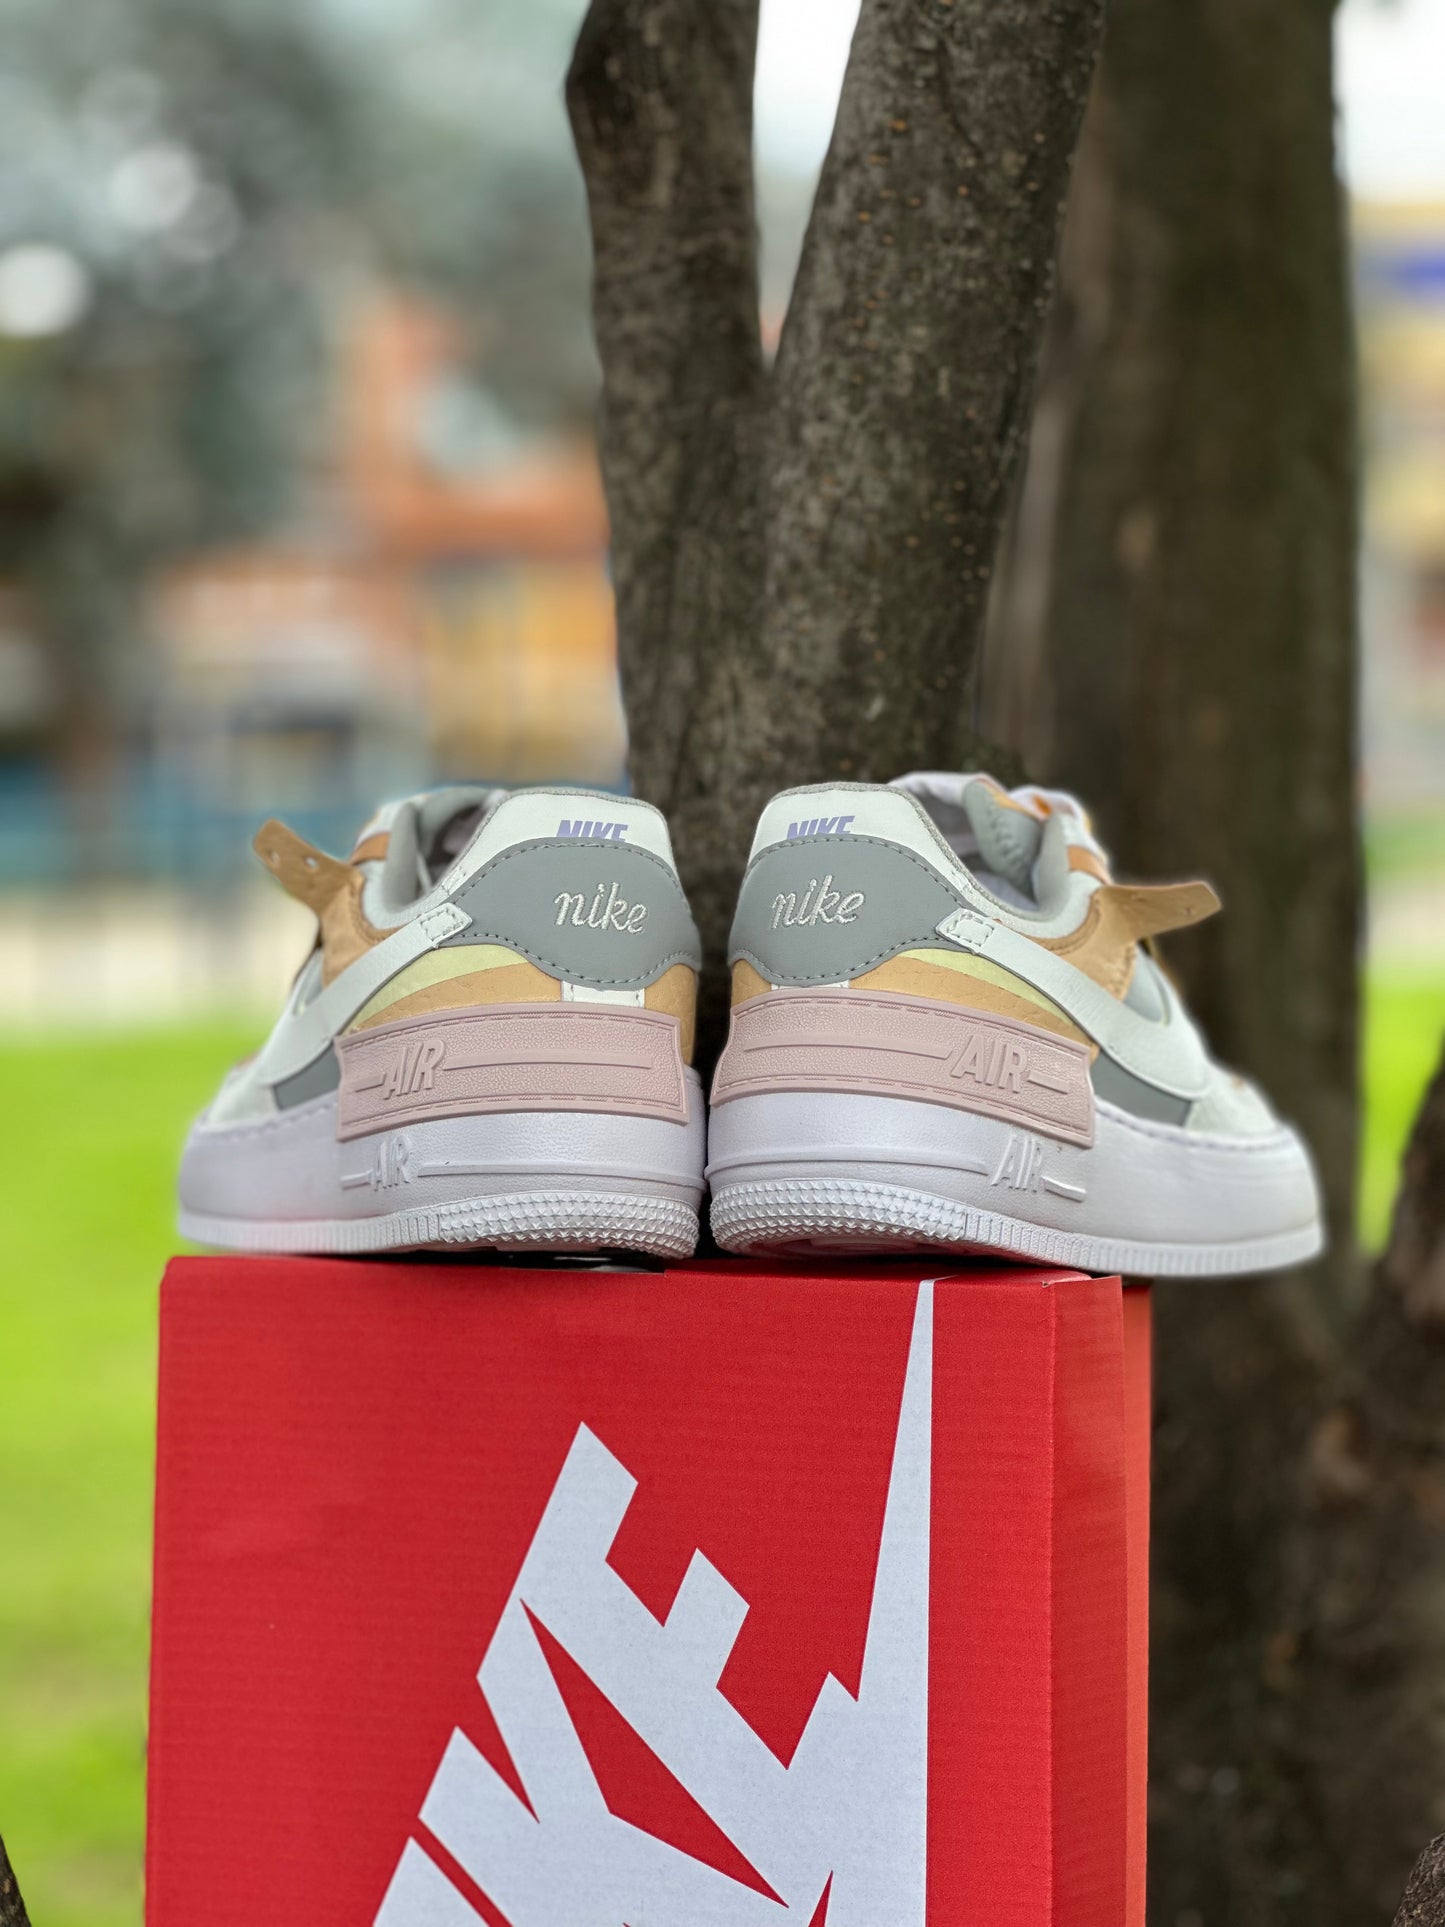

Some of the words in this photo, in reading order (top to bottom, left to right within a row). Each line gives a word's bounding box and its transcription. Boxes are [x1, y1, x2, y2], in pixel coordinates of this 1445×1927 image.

[553, 881, 649, 935] nike
[771, 875, 865, 929] nike
[383, 1039, 447, 1099] AIR
[951, 1034, 1028, 1093] AIR
[370, 1133, 412, 1191] AIR
[990, 1133, 1043, 1193] AIR
